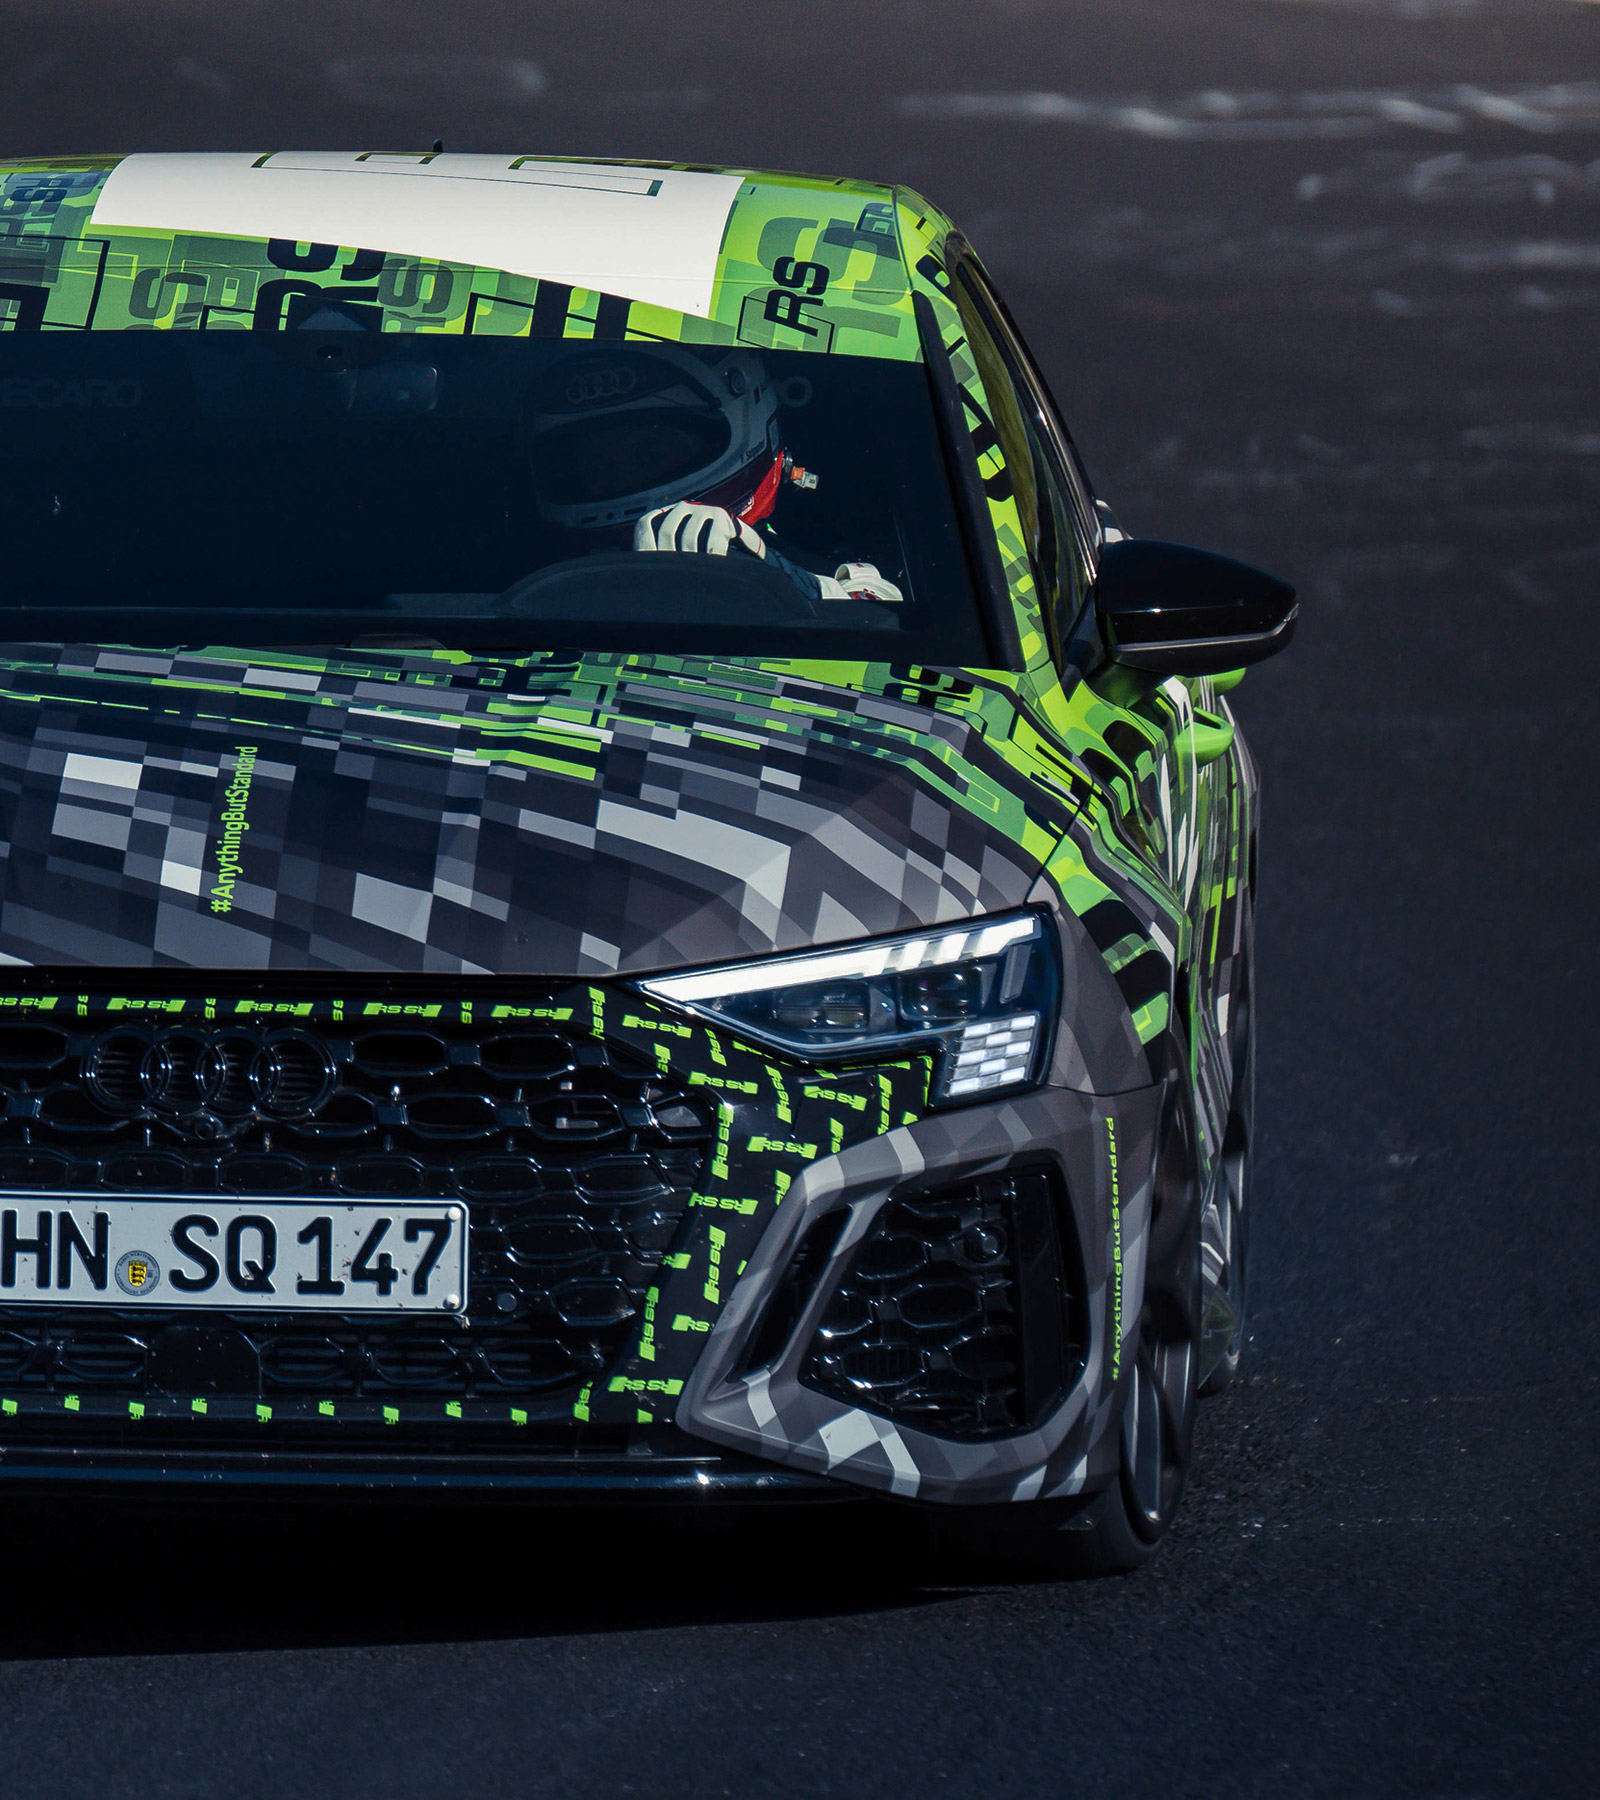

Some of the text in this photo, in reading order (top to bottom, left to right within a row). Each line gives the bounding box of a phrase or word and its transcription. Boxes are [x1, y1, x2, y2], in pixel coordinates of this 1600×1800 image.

[763, 256, 830, 338] RS
[210, 746, 258, 913] #AnythingButStandard
[0, 1208, 111, 1291] HN
[168, 1213, 278, 1294] SQ
[295, 1217, 453, 1296] 147
[1105, 1117, 1122, 1381] #AnythingButStandard
